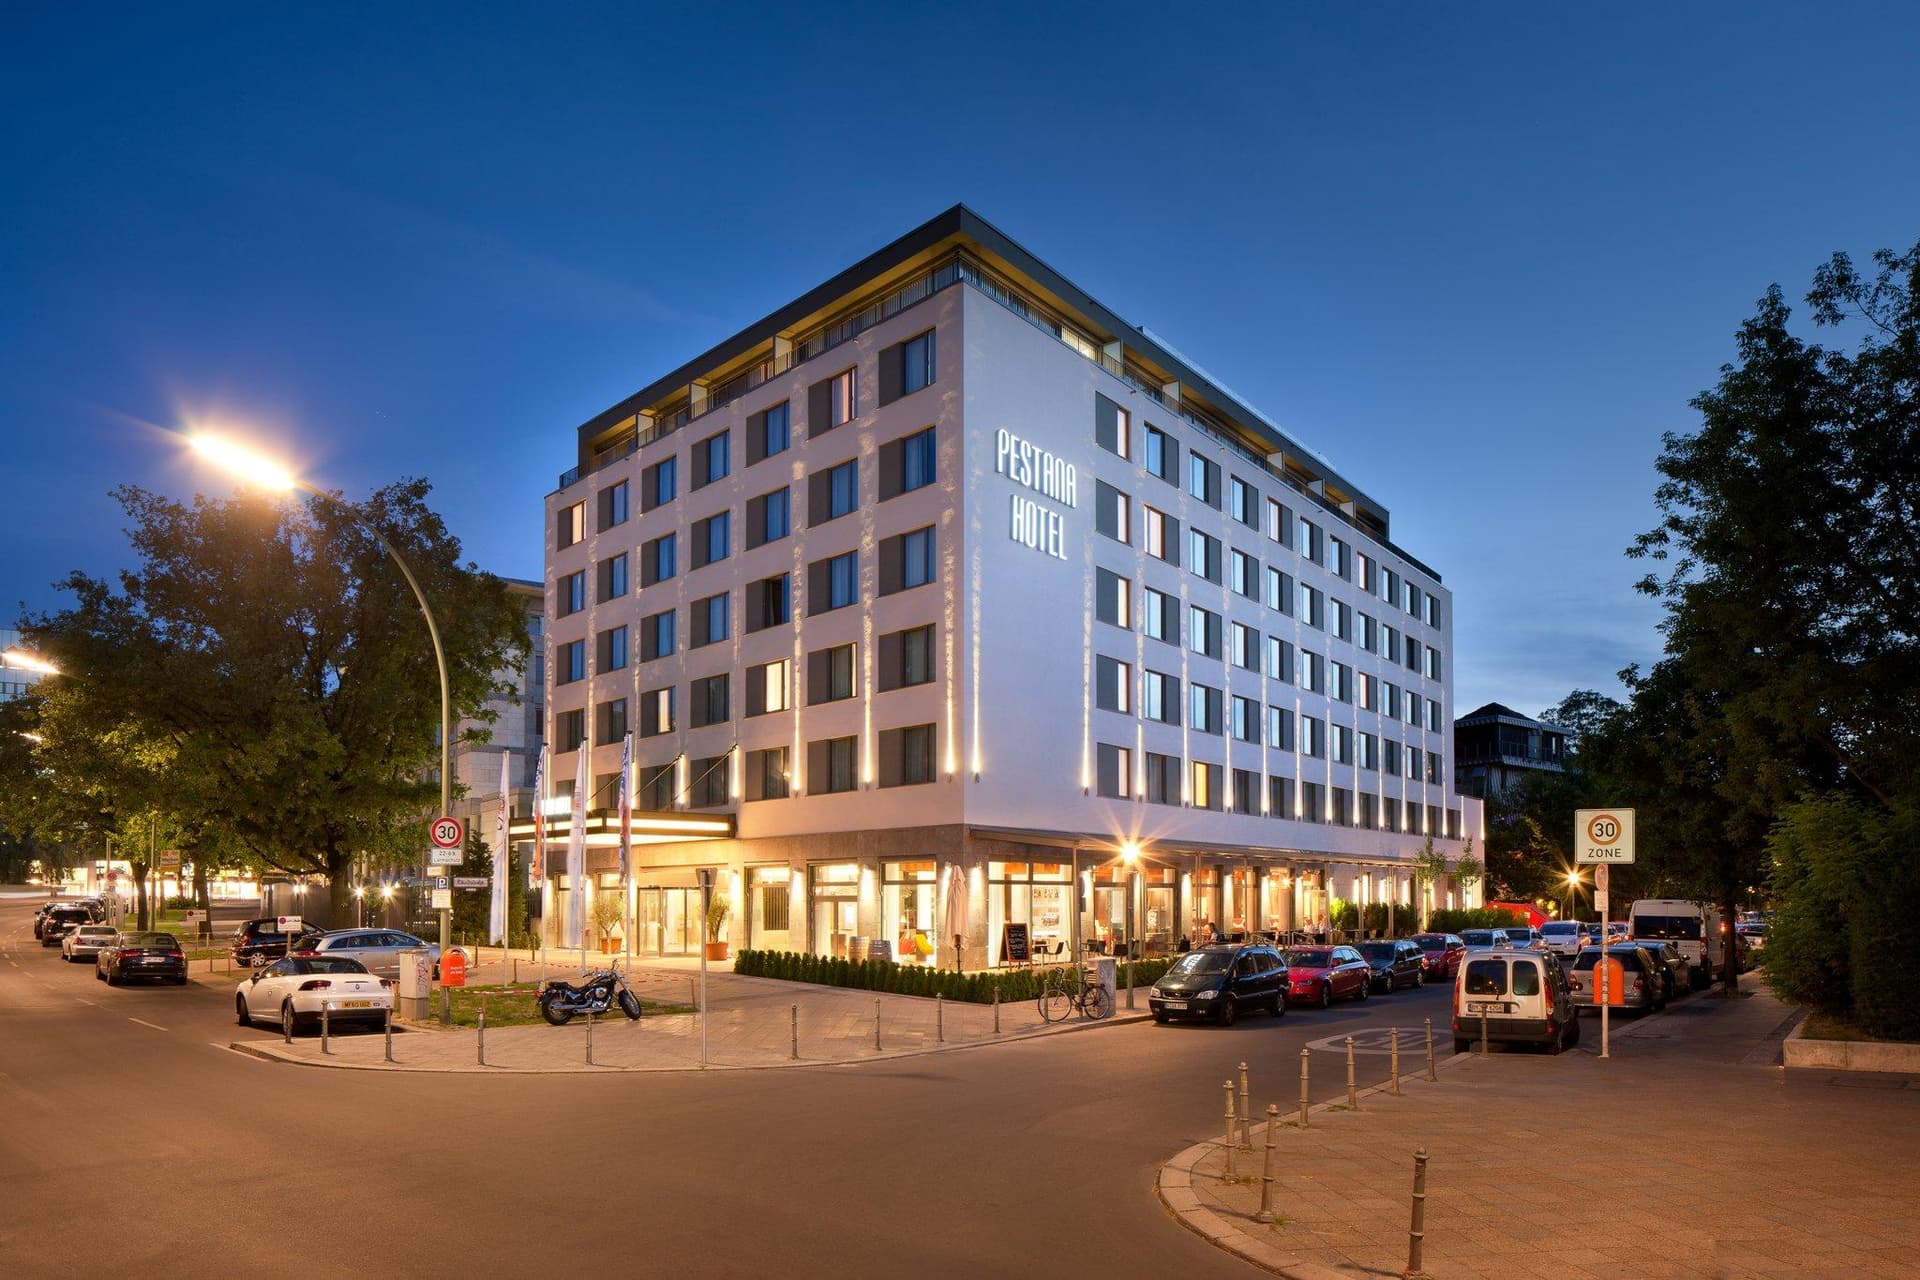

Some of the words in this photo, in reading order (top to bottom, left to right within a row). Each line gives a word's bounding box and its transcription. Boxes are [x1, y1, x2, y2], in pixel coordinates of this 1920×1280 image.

[997, 428, 1076, 508] PESTANA
[1011, 494, 1068, 561] HOTEL
[438, 825, 456, 840] 30
[1594, 822, 1615, 838] 30
[1588, 848, 1622, 858] ZONE
